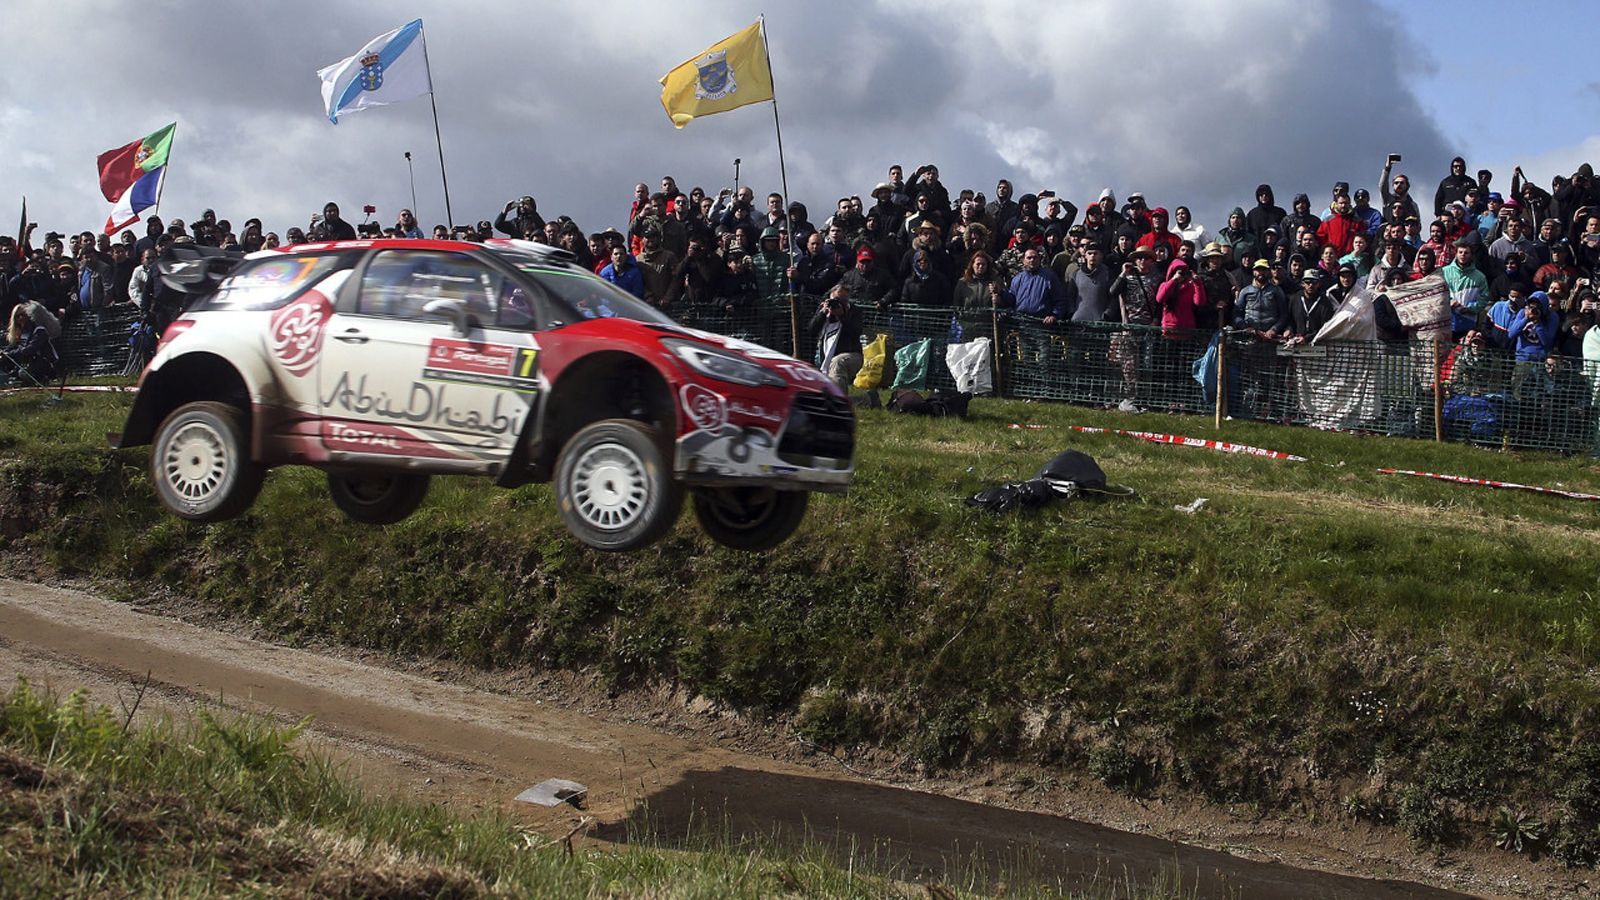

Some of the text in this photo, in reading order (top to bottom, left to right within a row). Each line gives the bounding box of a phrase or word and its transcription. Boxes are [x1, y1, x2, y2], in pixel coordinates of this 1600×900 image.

[452, 350, 509, 366] Portugal
[519, 349, 537, 377] 7
[328, 423, 402, 449] TOTAL
